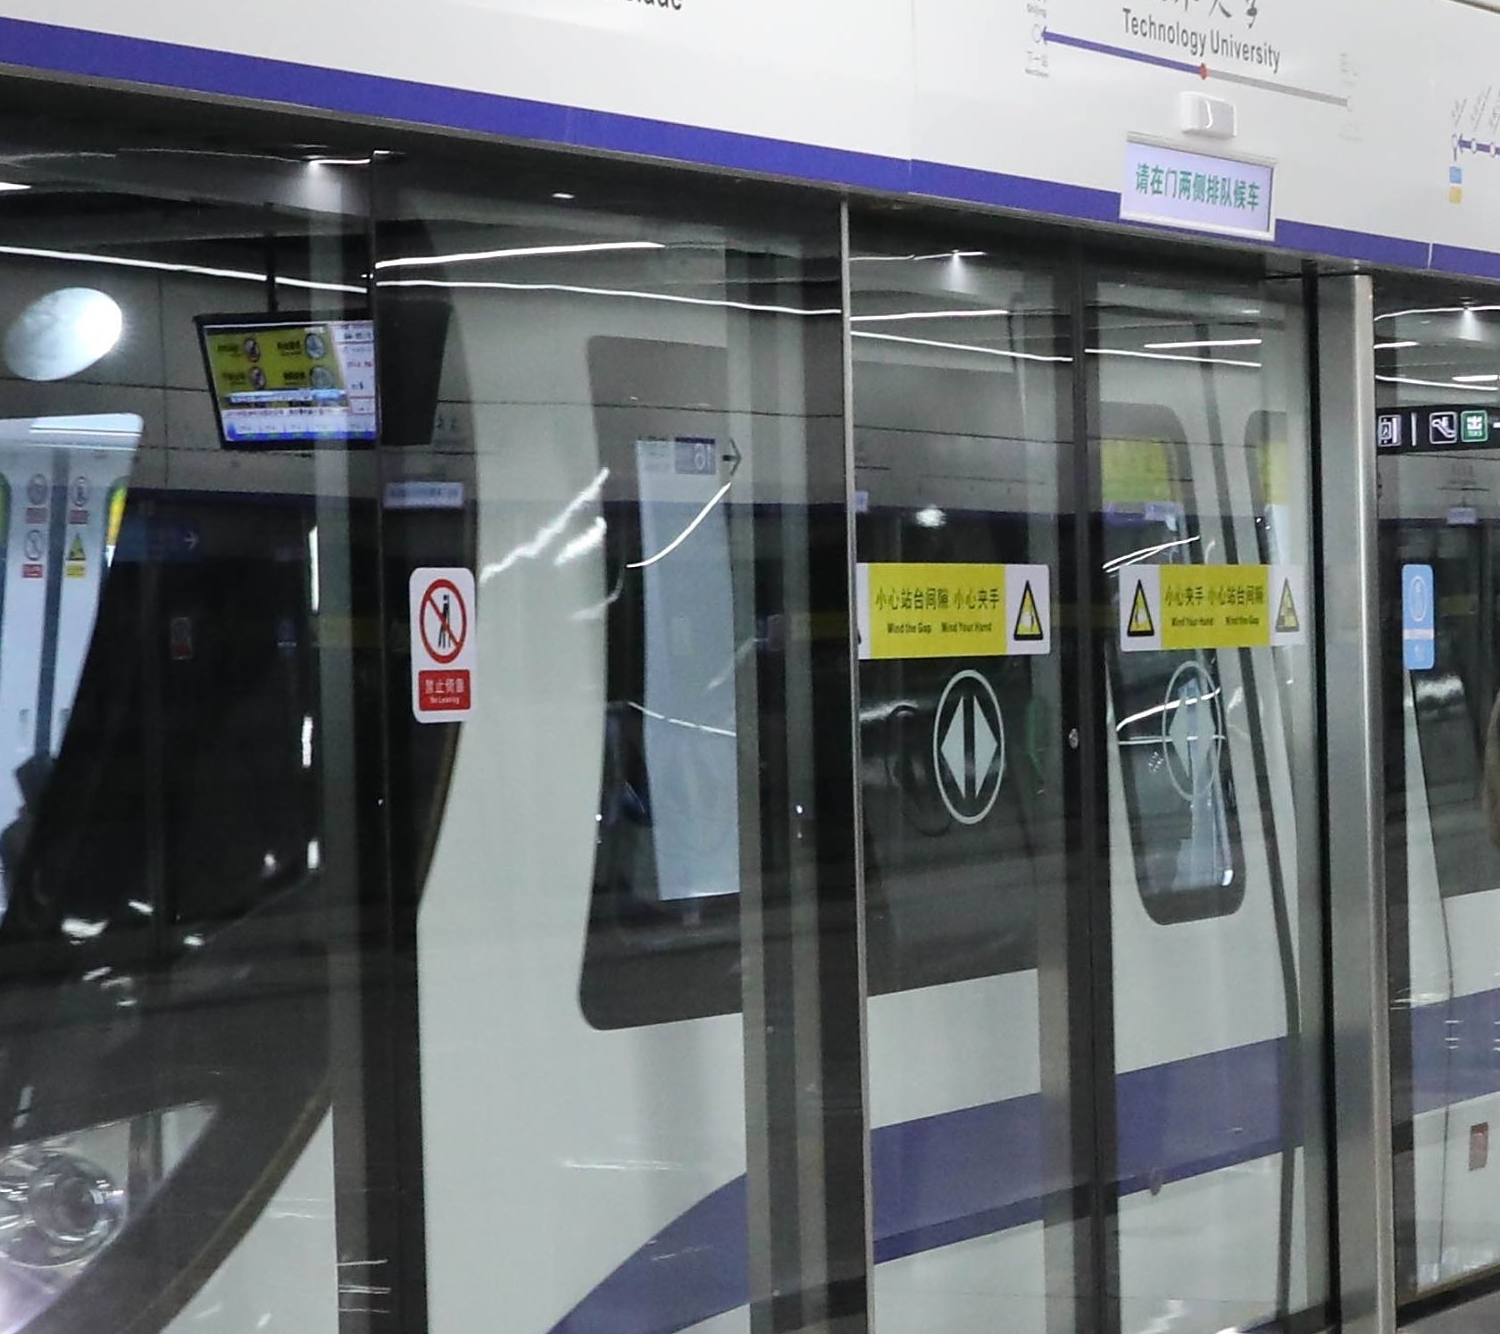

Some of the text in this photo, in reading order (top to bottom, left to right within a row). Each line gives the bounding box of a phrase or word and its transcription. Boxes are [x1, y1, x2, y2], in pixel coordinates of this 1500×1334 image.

[1122, 7, 1207, 58] Technology
[1210, 29, 1281, 74] University
[1134, 162, 1261, 212] 请在门两侧排队候车
